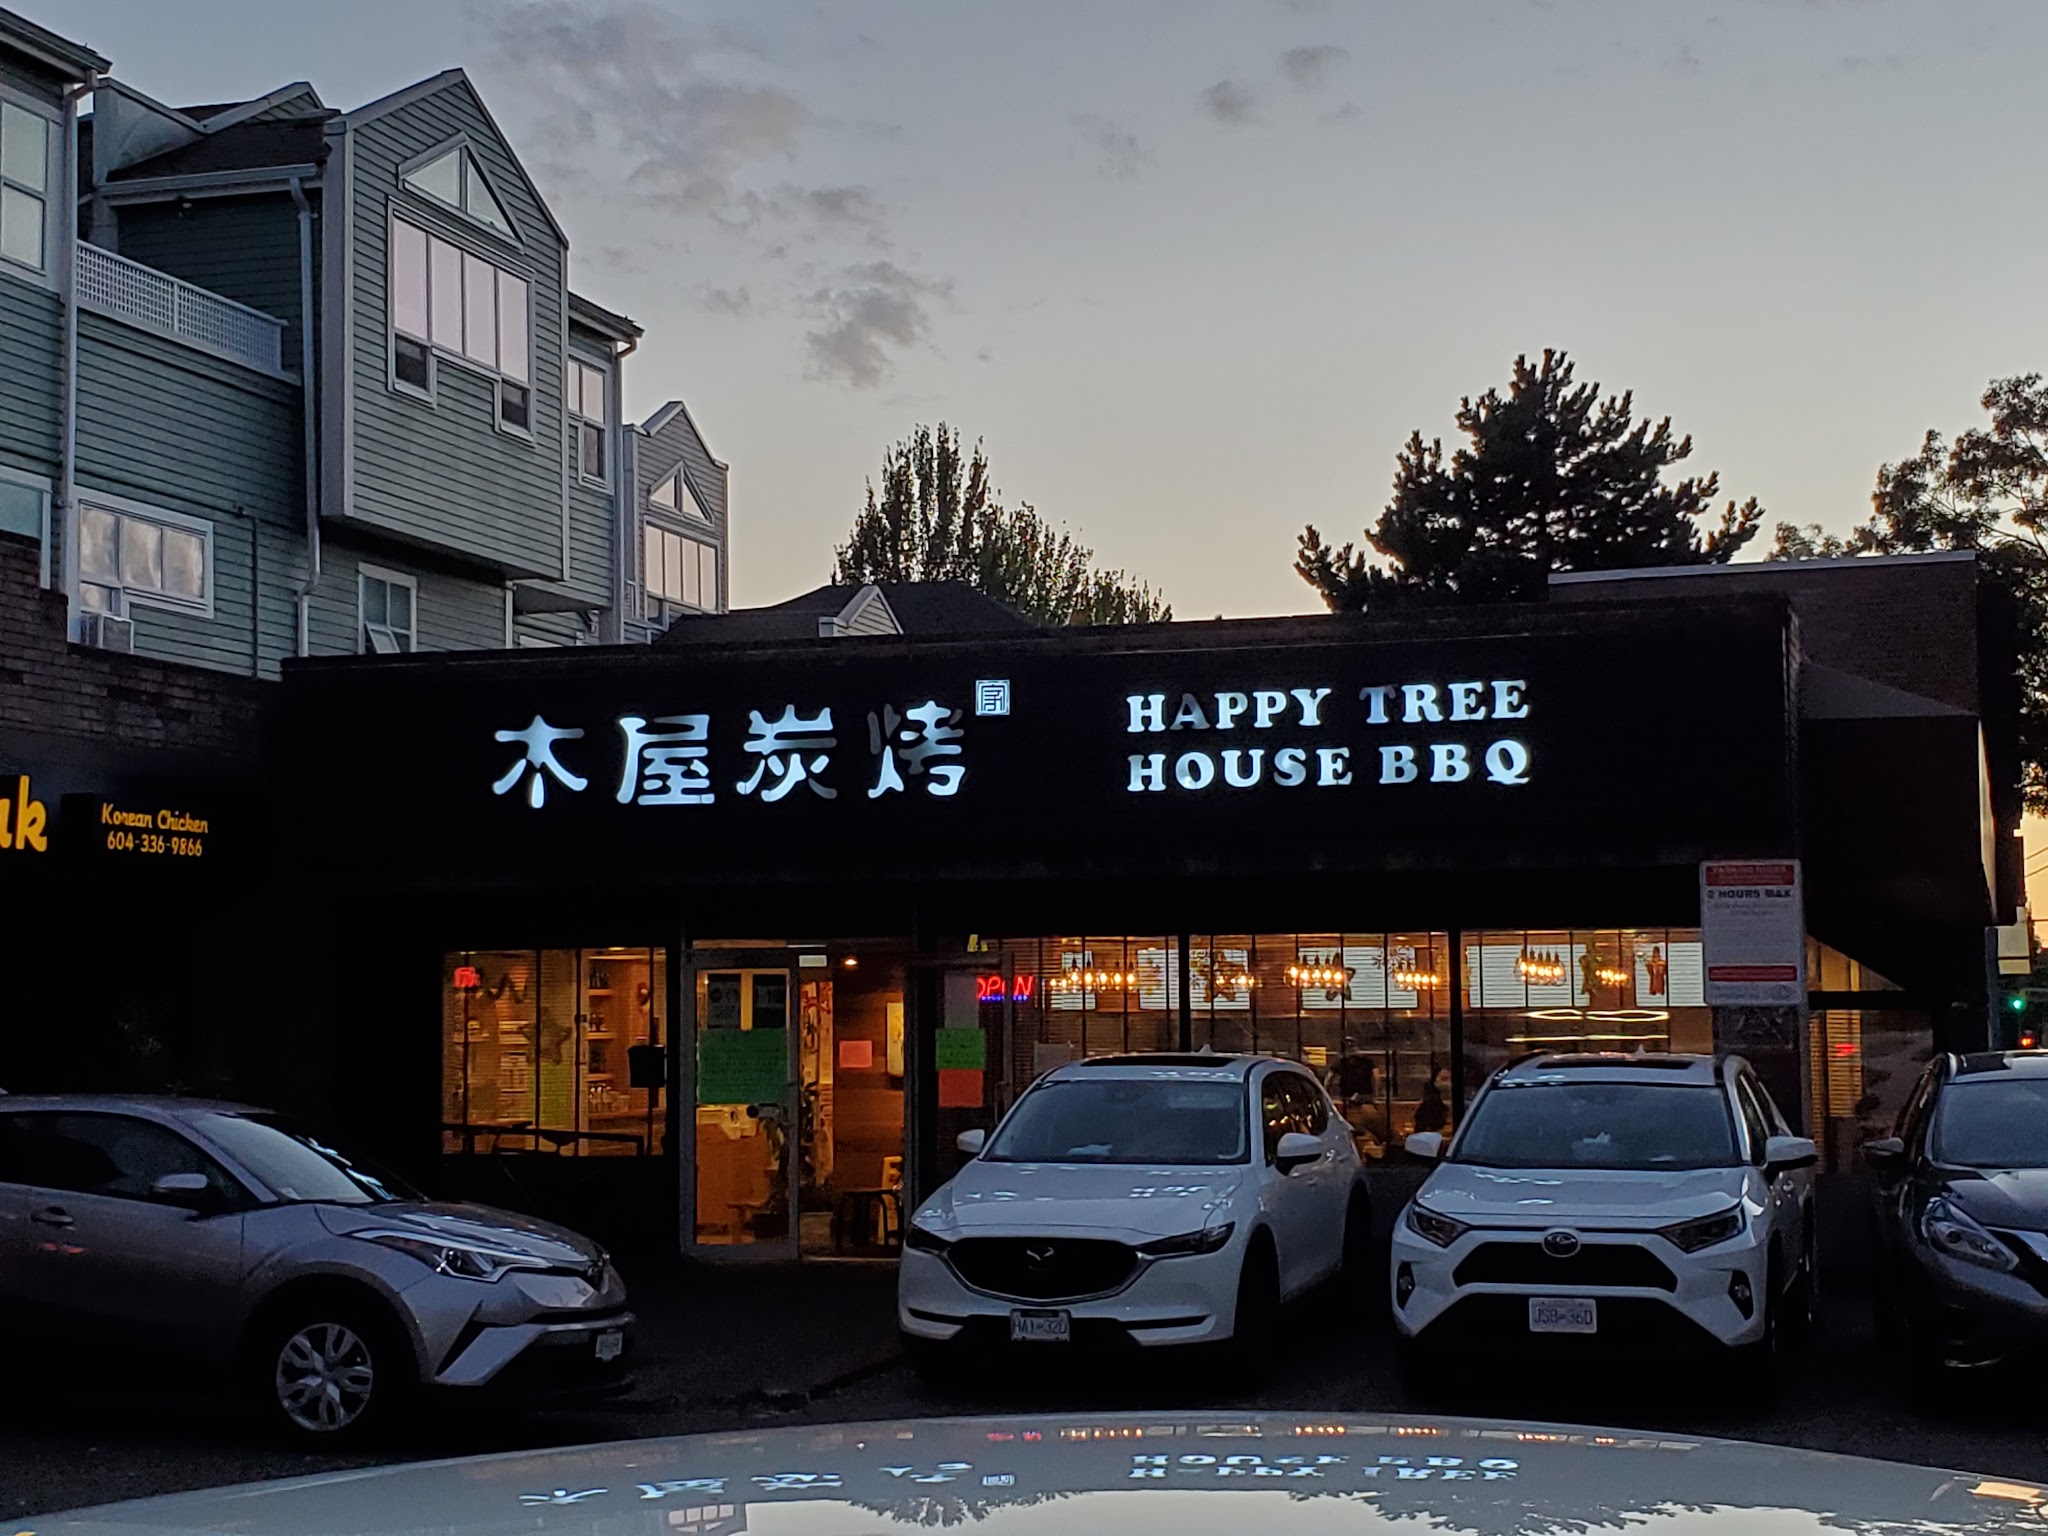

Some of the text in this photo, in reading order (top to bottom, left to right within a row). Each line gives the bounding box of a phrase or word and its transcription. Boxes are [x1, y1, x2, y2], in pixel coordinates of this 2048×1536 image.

[1126, 679, 1531, 732] HAPPY TREE
[492, 700, 968, 809] 木屋炭烤
[1126, 739, 1530, 792] HOUSE BBQ
[101, 803, 208, 833] Korean Chicken
[107, 831, 203, 857] 604-336-9866
[1718, 889, 1760, 899] HOURS
